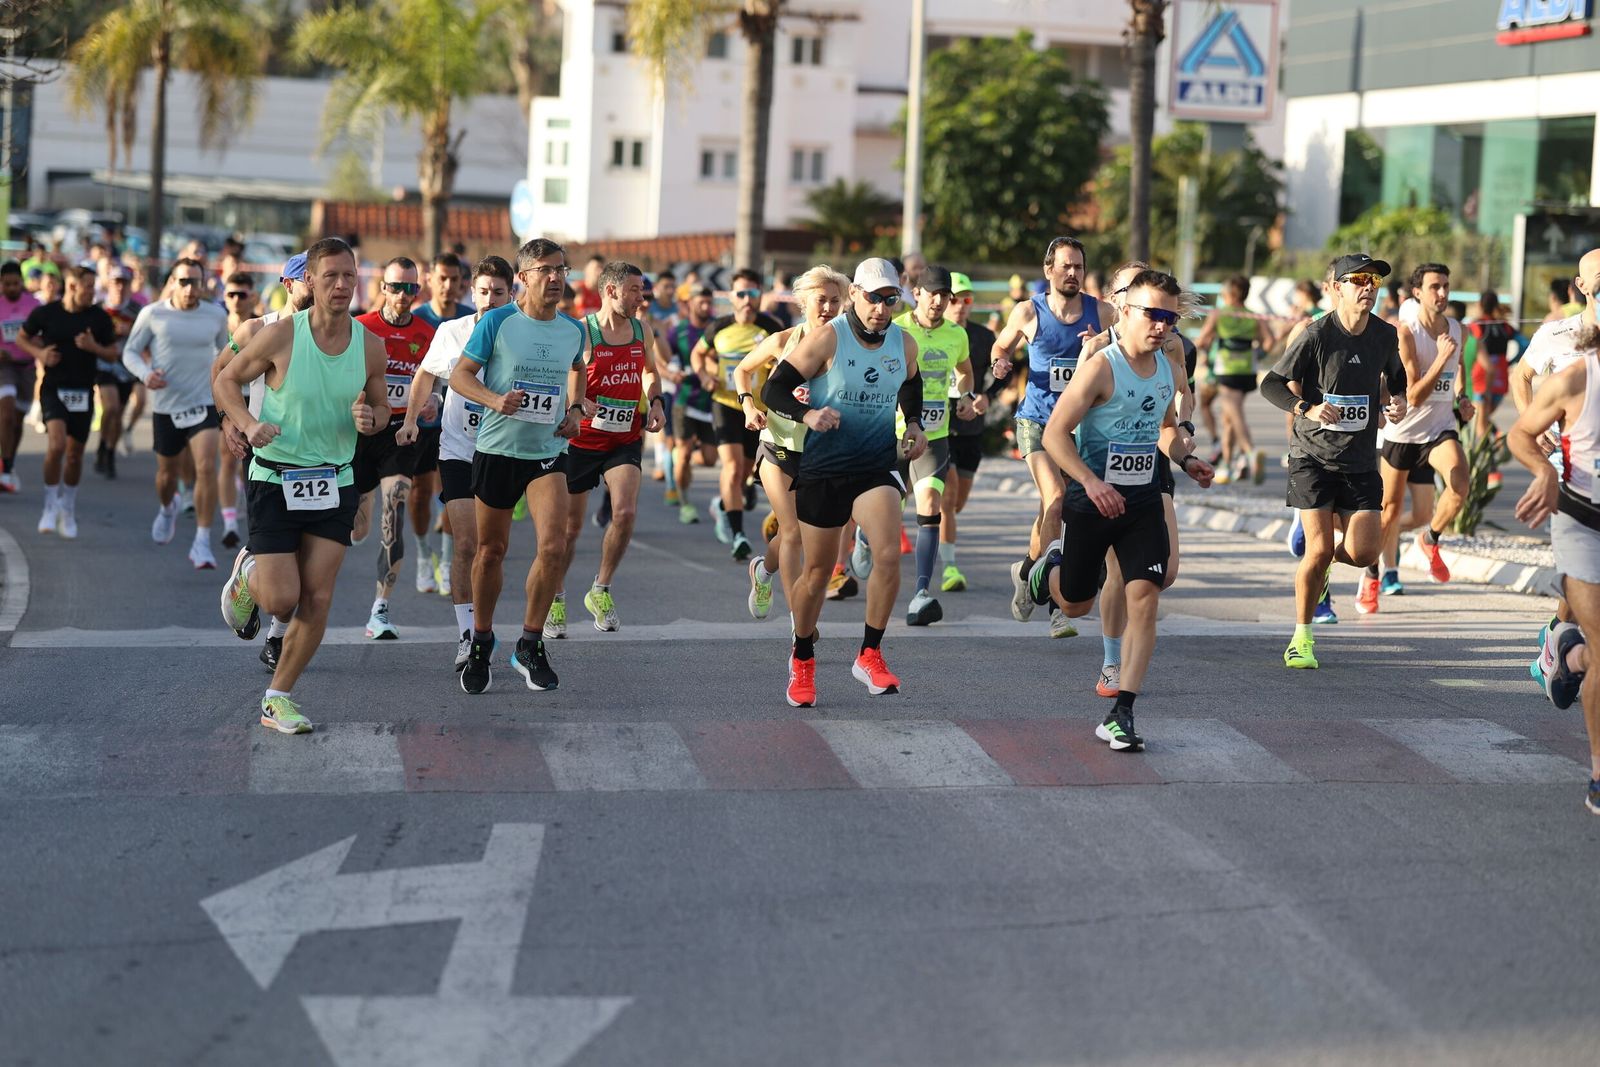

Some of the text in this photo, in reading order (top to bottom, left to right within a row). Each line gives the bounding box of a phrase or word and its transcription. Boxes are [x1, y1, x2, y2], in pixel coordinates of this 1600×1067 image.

[1183, 81, 1258, 104] ALDI
[615, 363, 629, 371] did
[631, 362, 637, 370] it
[1053, 368, 1076, 381] 10
[601, 372, 640, 386] AGAIN
[520, 393, 552, 411] 314
[597, 407, 632, 422] 2168
[1110, 454, 1153, 471] 2088
[292, 480, 330, 498] 212
